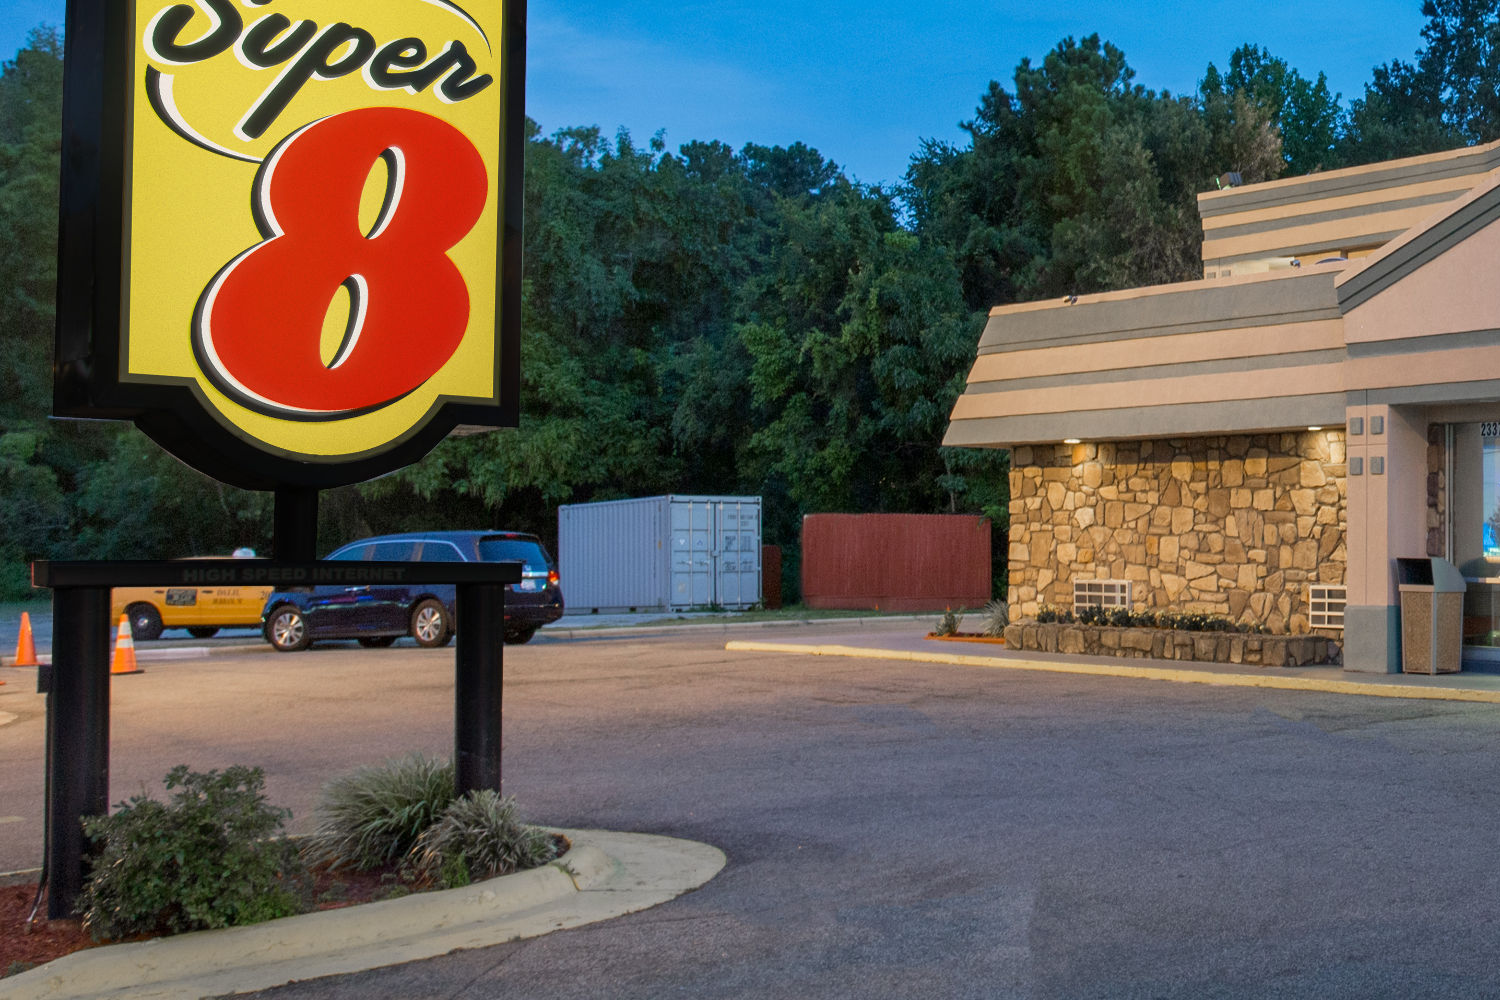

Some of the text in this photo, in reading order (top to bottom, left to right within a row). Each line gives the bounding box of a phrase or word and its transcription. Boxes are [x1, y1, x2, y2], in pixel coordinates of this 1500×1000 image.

[194, 107, 488, 419] 8
[183, 568, 405, 582] HIGH SPEED INTERNET
